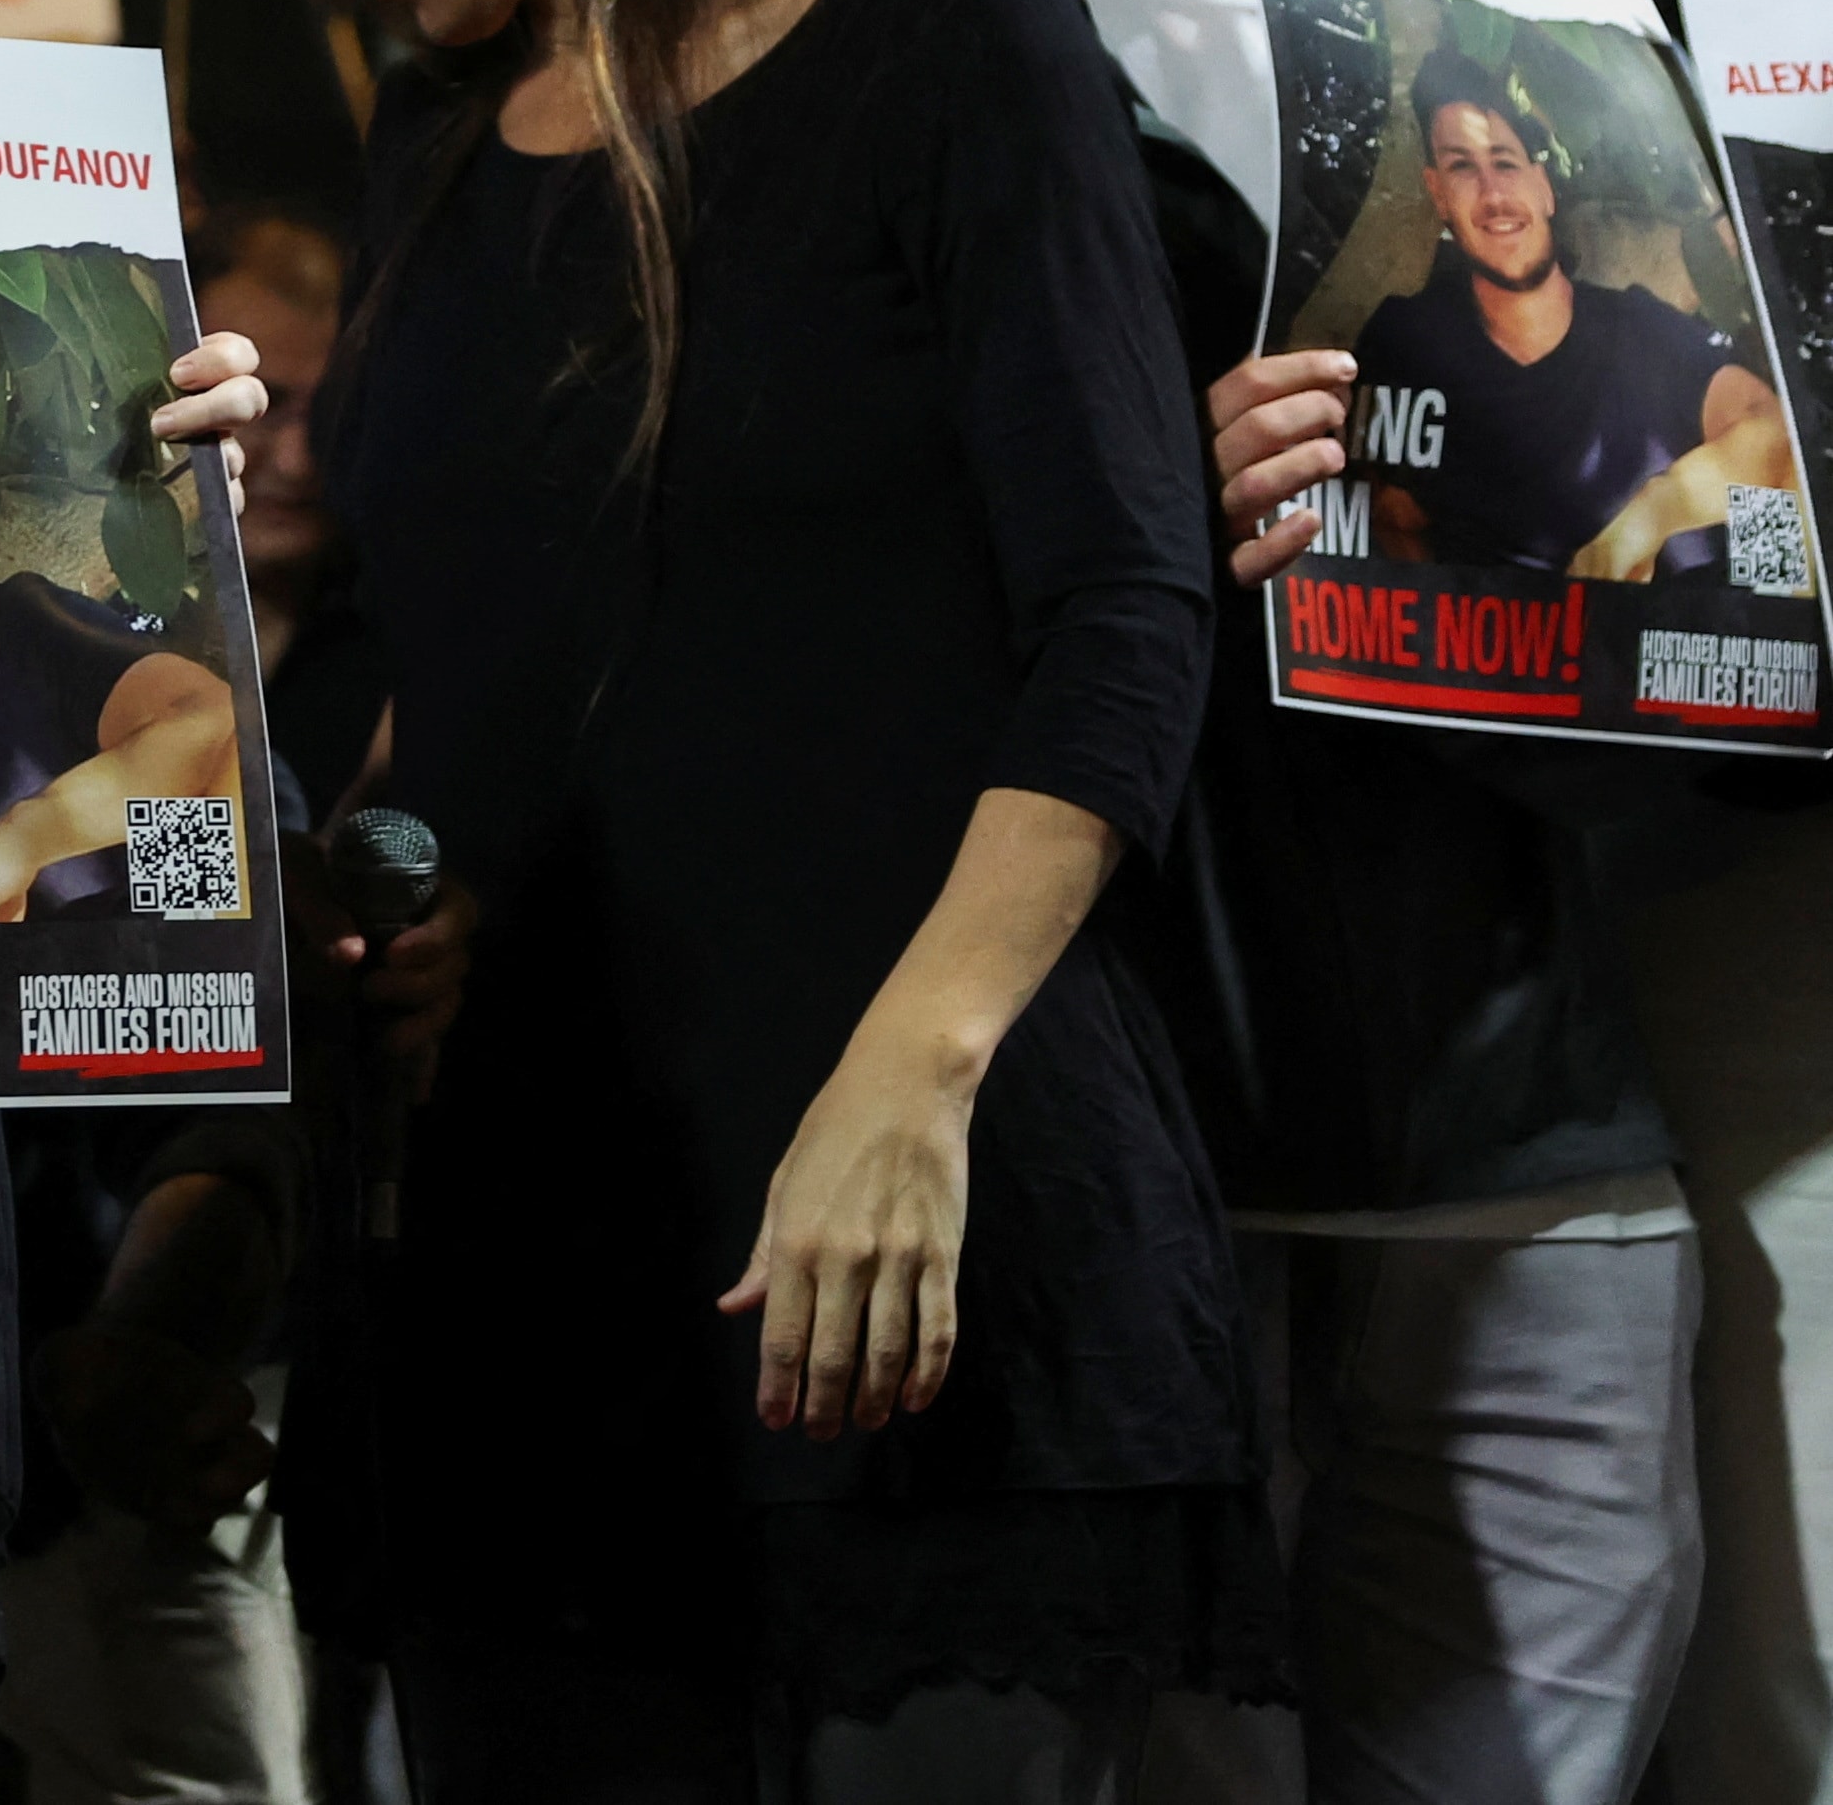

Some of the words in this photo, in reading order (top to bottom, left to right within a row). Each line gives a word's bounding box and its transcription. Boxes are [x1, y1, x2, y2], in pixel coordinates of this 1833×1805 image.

[1727, 61, 1833, 94] ALEXA
[1349, 384, 1447, 469] ING
[1286, 575, 1421, 668] HOME
[1436, 582, 1587, 683] NOW!
[1640, 628, 1719, 665] HOSTAGES
[1721, 636, 1752, 668] AND
[1753, 638, 1819, 673] MISSING
[1638, 659, 1738, 708] FAMILIES
[1741, 669, 1819, 714] FORUM
[19, 973, 120, 1010] HOSTAGES
[124, 973, 164, 1008] AND
[166, 972, 255, 1007] MISSING
[21, 1007, 150, 1057] FAMILIES
[155, 1006, 257, 1054] FORUM
